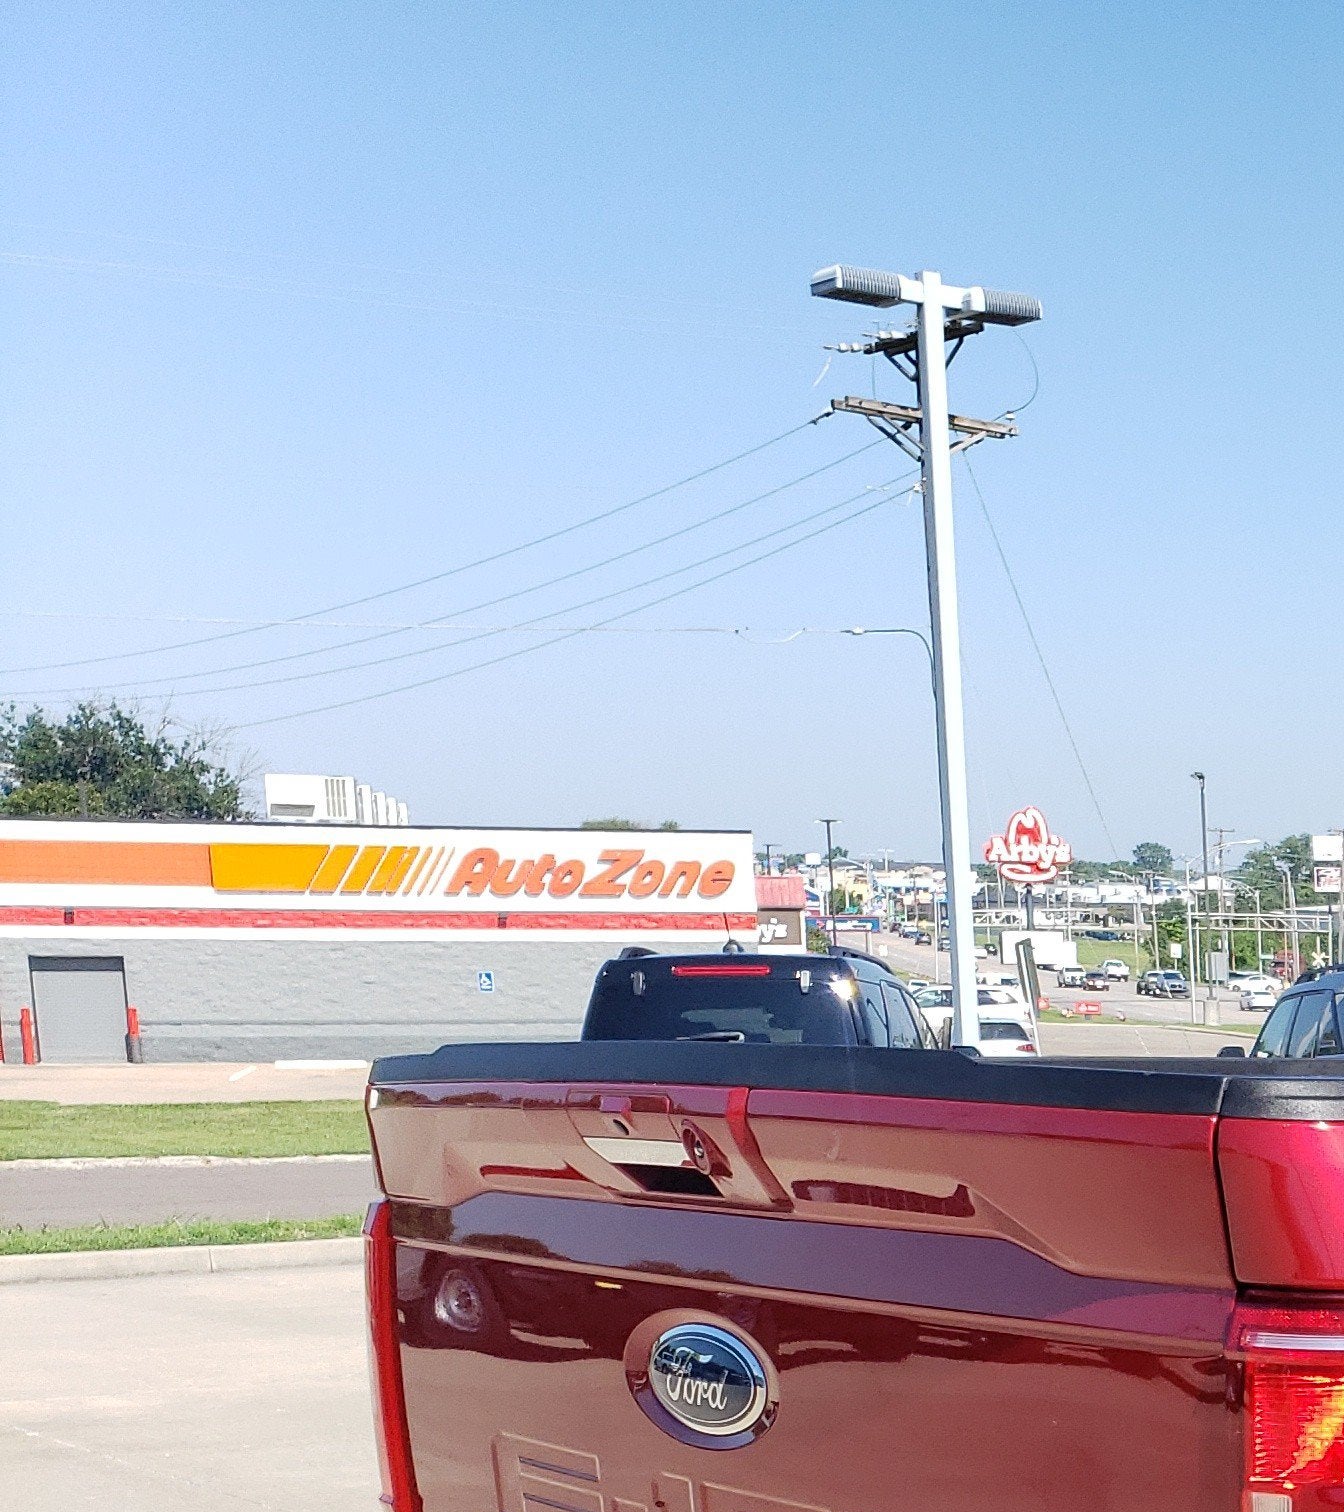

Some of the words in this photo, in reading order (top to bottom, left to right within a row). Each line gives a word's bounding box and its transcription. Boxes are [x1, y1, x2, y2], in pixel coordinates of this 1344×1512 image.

[443, 847, 736, 899] AutoZone
[987, 834, 1071, 869] Arby's
[666, 1346, 729, 1410] Ford
